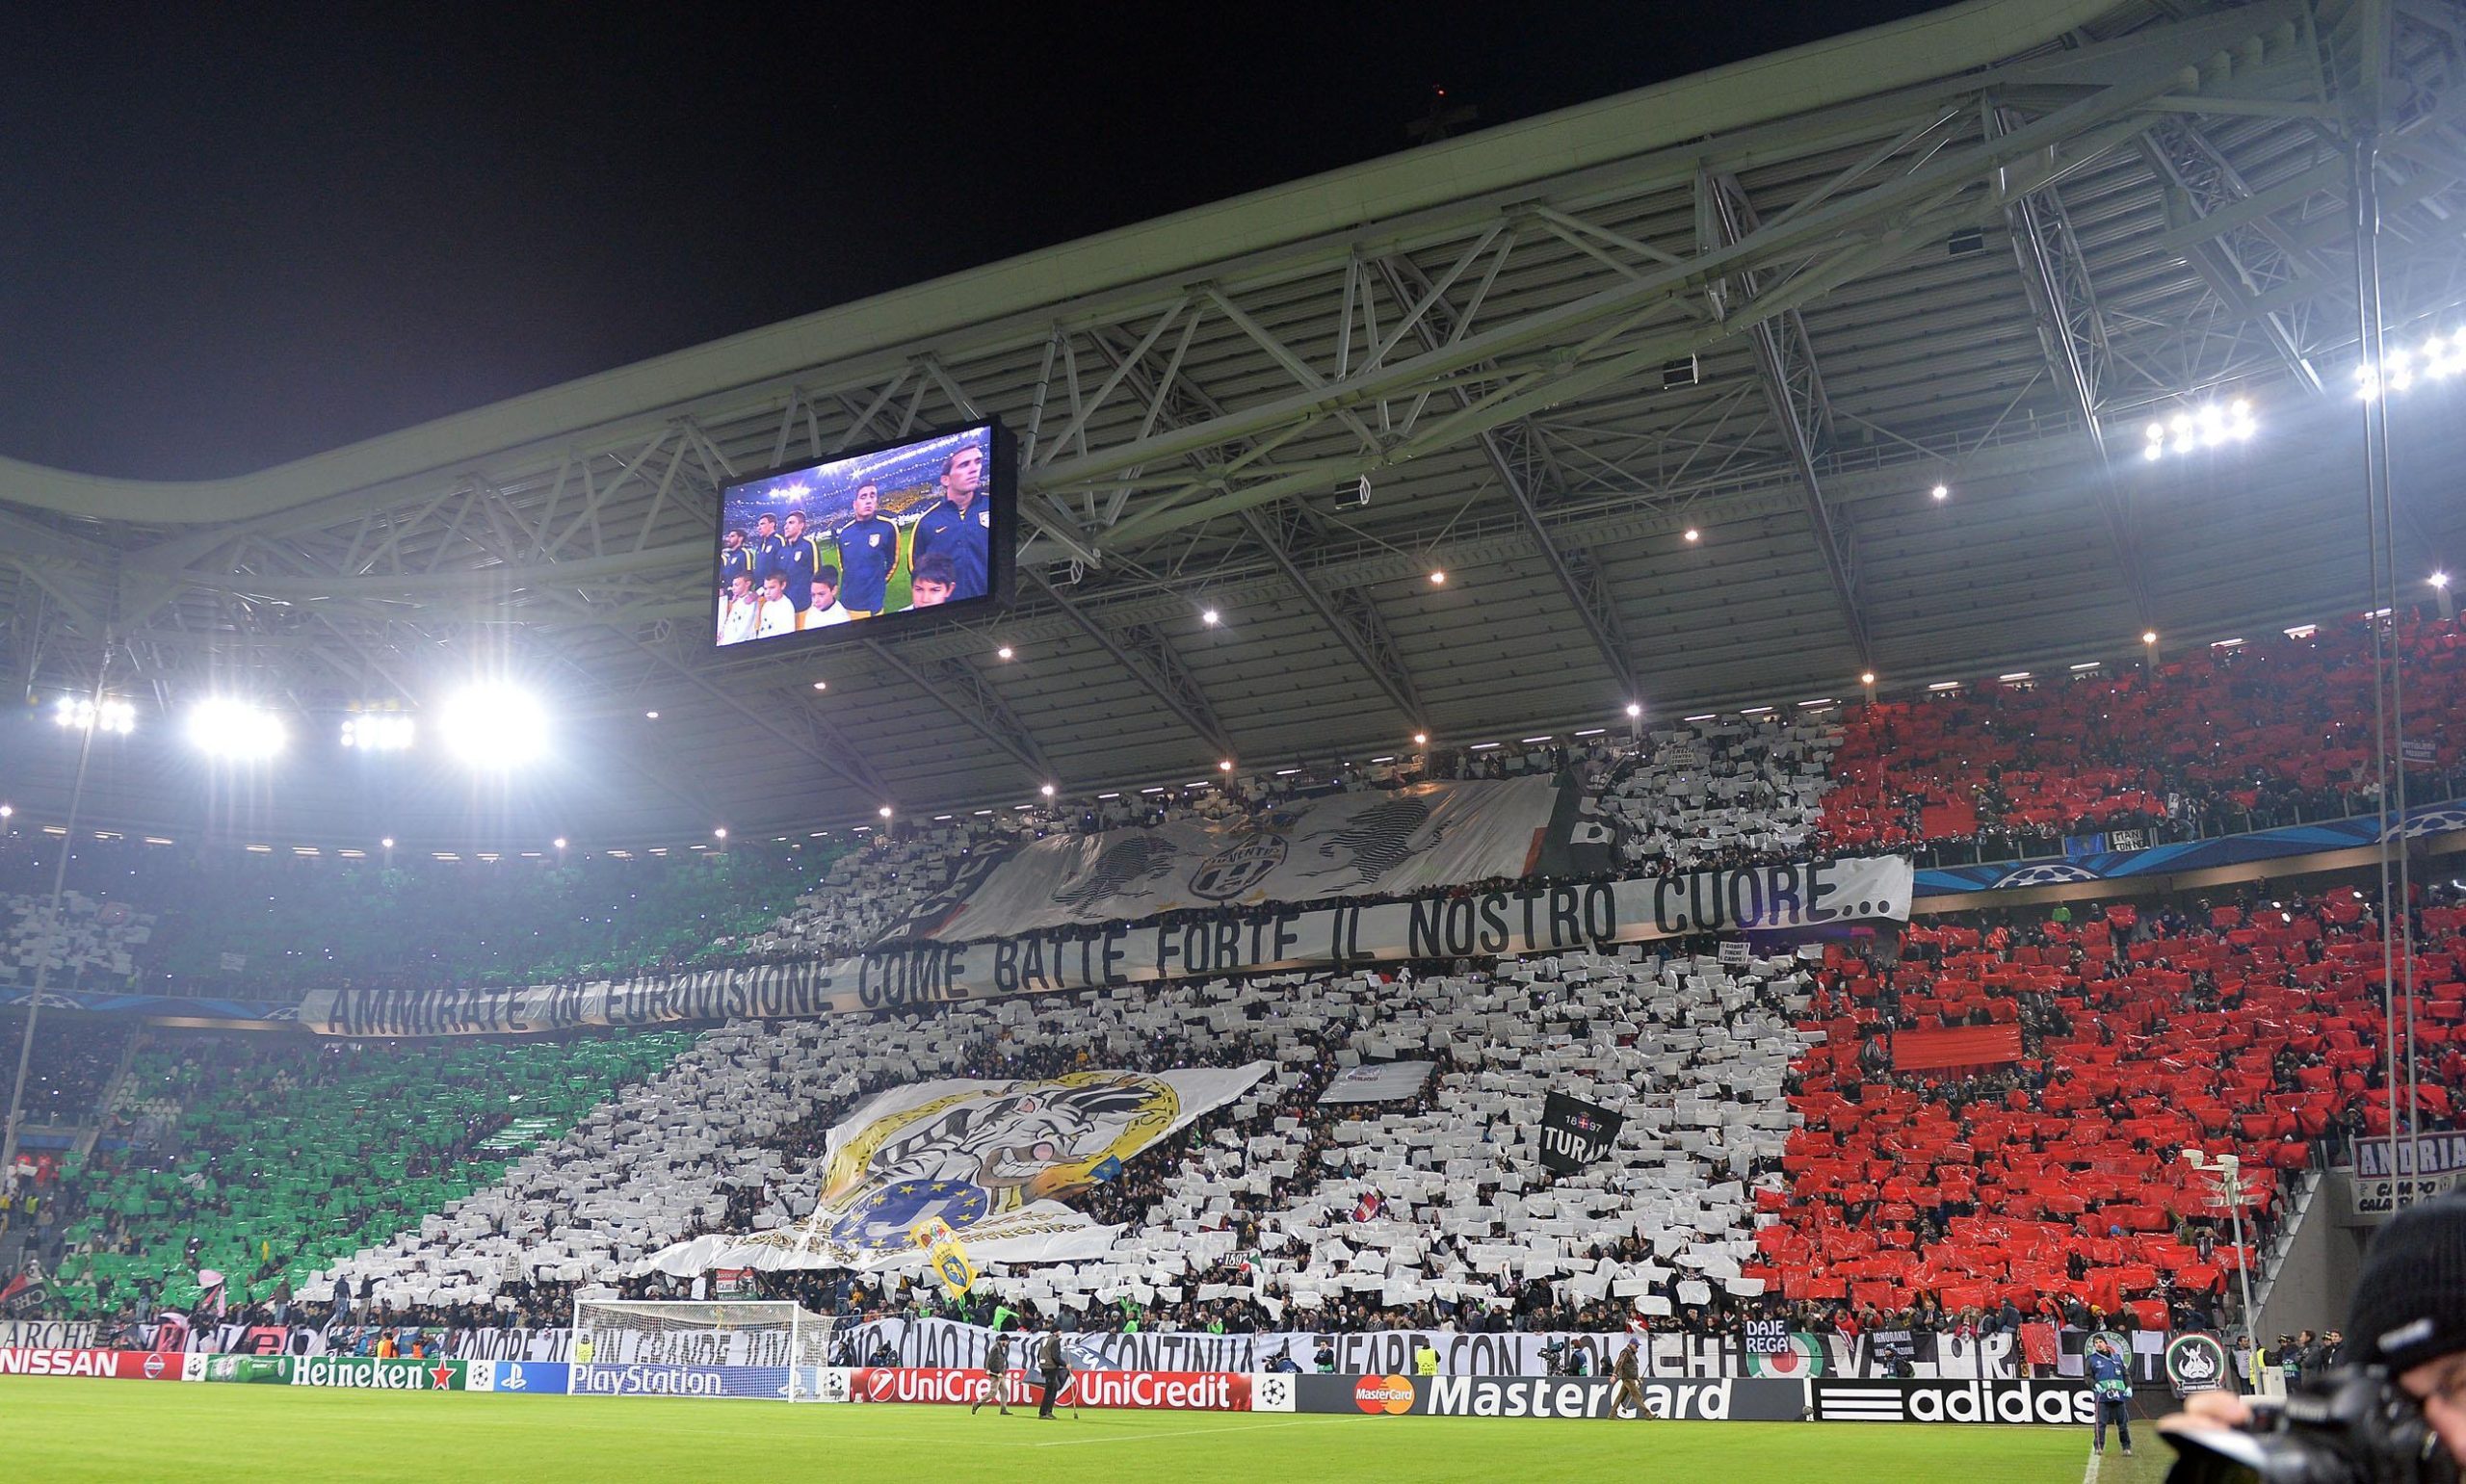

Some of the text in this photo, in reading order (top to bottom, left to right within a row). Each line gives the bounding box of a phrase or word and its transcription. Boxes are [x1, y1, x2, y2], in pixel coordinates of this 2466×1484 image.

[328, 987, 528, 1035] AMMIRATE
[550, 982, 585, 1028] IN
[858, 947, 969, 1008] COME
[994, 929, 1128, 992] BATTE
[1158, 913, 1300, 978] FORTE
[1331, 907, 1376, 961] IL
[1408, 882, 1617, 957] NOSTRO
[1655, 860, 1891, 934] CUORE...
[1565, 1115, 1603, 1133] 18 97
[2360, 1136, 2466, 1175] ANDRIA
[1224, 1253, 1248, 1265] 1897
[1746, 1319, 1786, 1336] DAJE
[1873, 1330, 1912, 1342] IGNORANZA
[0, 1350, 119, 1377] NISSAN
[899, 1322, 958, 1368] CIAO
[1449, 1335, 1521, 1376] CON
[290, 1355, 426, 1390] Heineken
[574, 1365, 722, 1395] PlayStation
[1081, 1372, 1230, 1409] UniCredit
[1355, 1388, 1414, 1401] MasterCard
[1908, 1380, 2096, 1424] adidas
